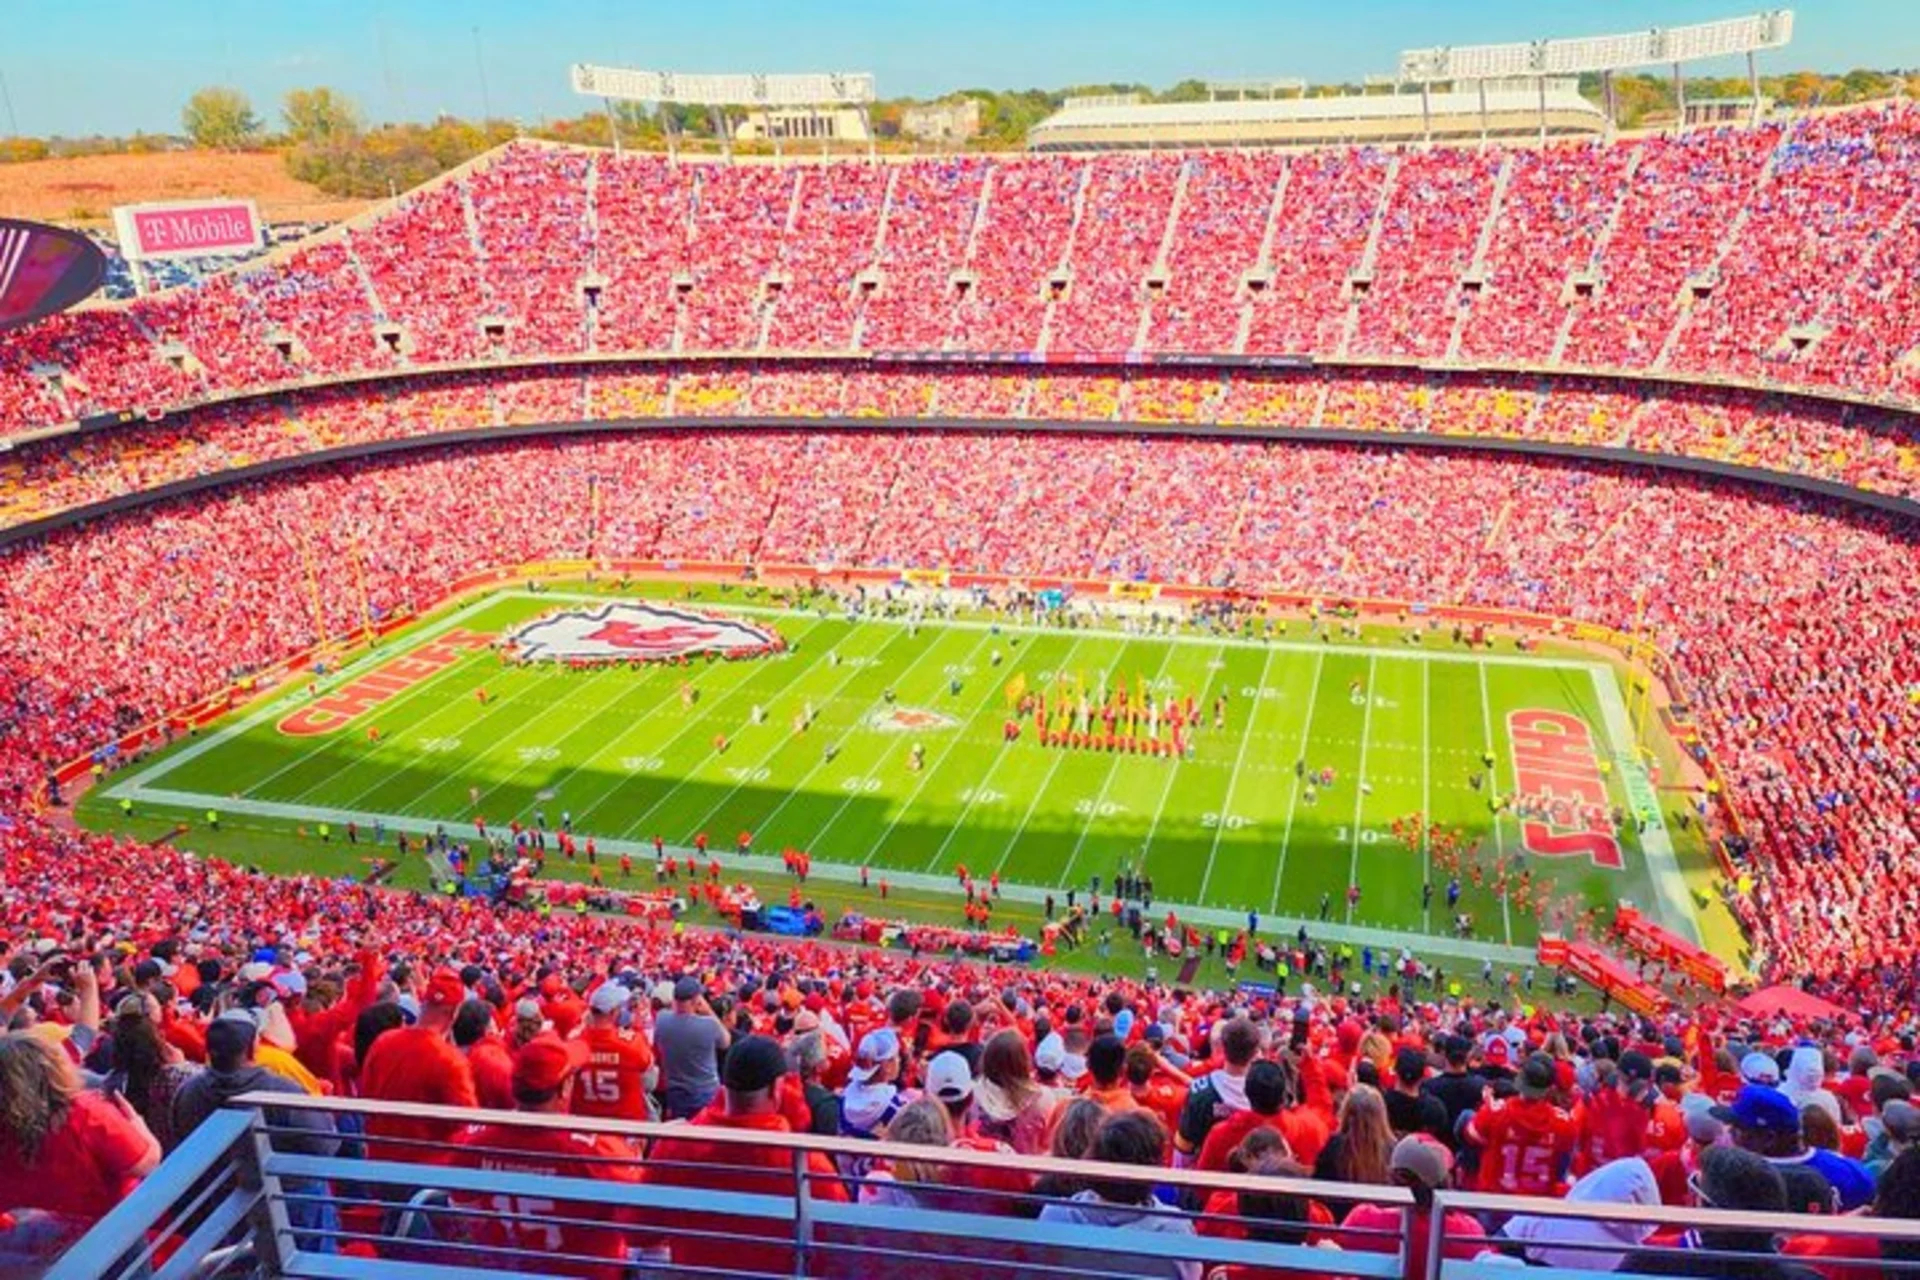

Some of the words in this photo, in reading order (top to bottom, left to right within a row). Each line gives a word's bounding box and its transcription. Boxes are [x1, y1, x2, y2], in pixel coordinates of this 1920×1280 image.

[171, 213, 246, 244] Mobile
[1202, 812, 1244, 830] 20
[1336, 826, 1379, 844] 10
[581, 1070, 620, 1102] 15
[1501, 1143, 1551, 1189] 15
